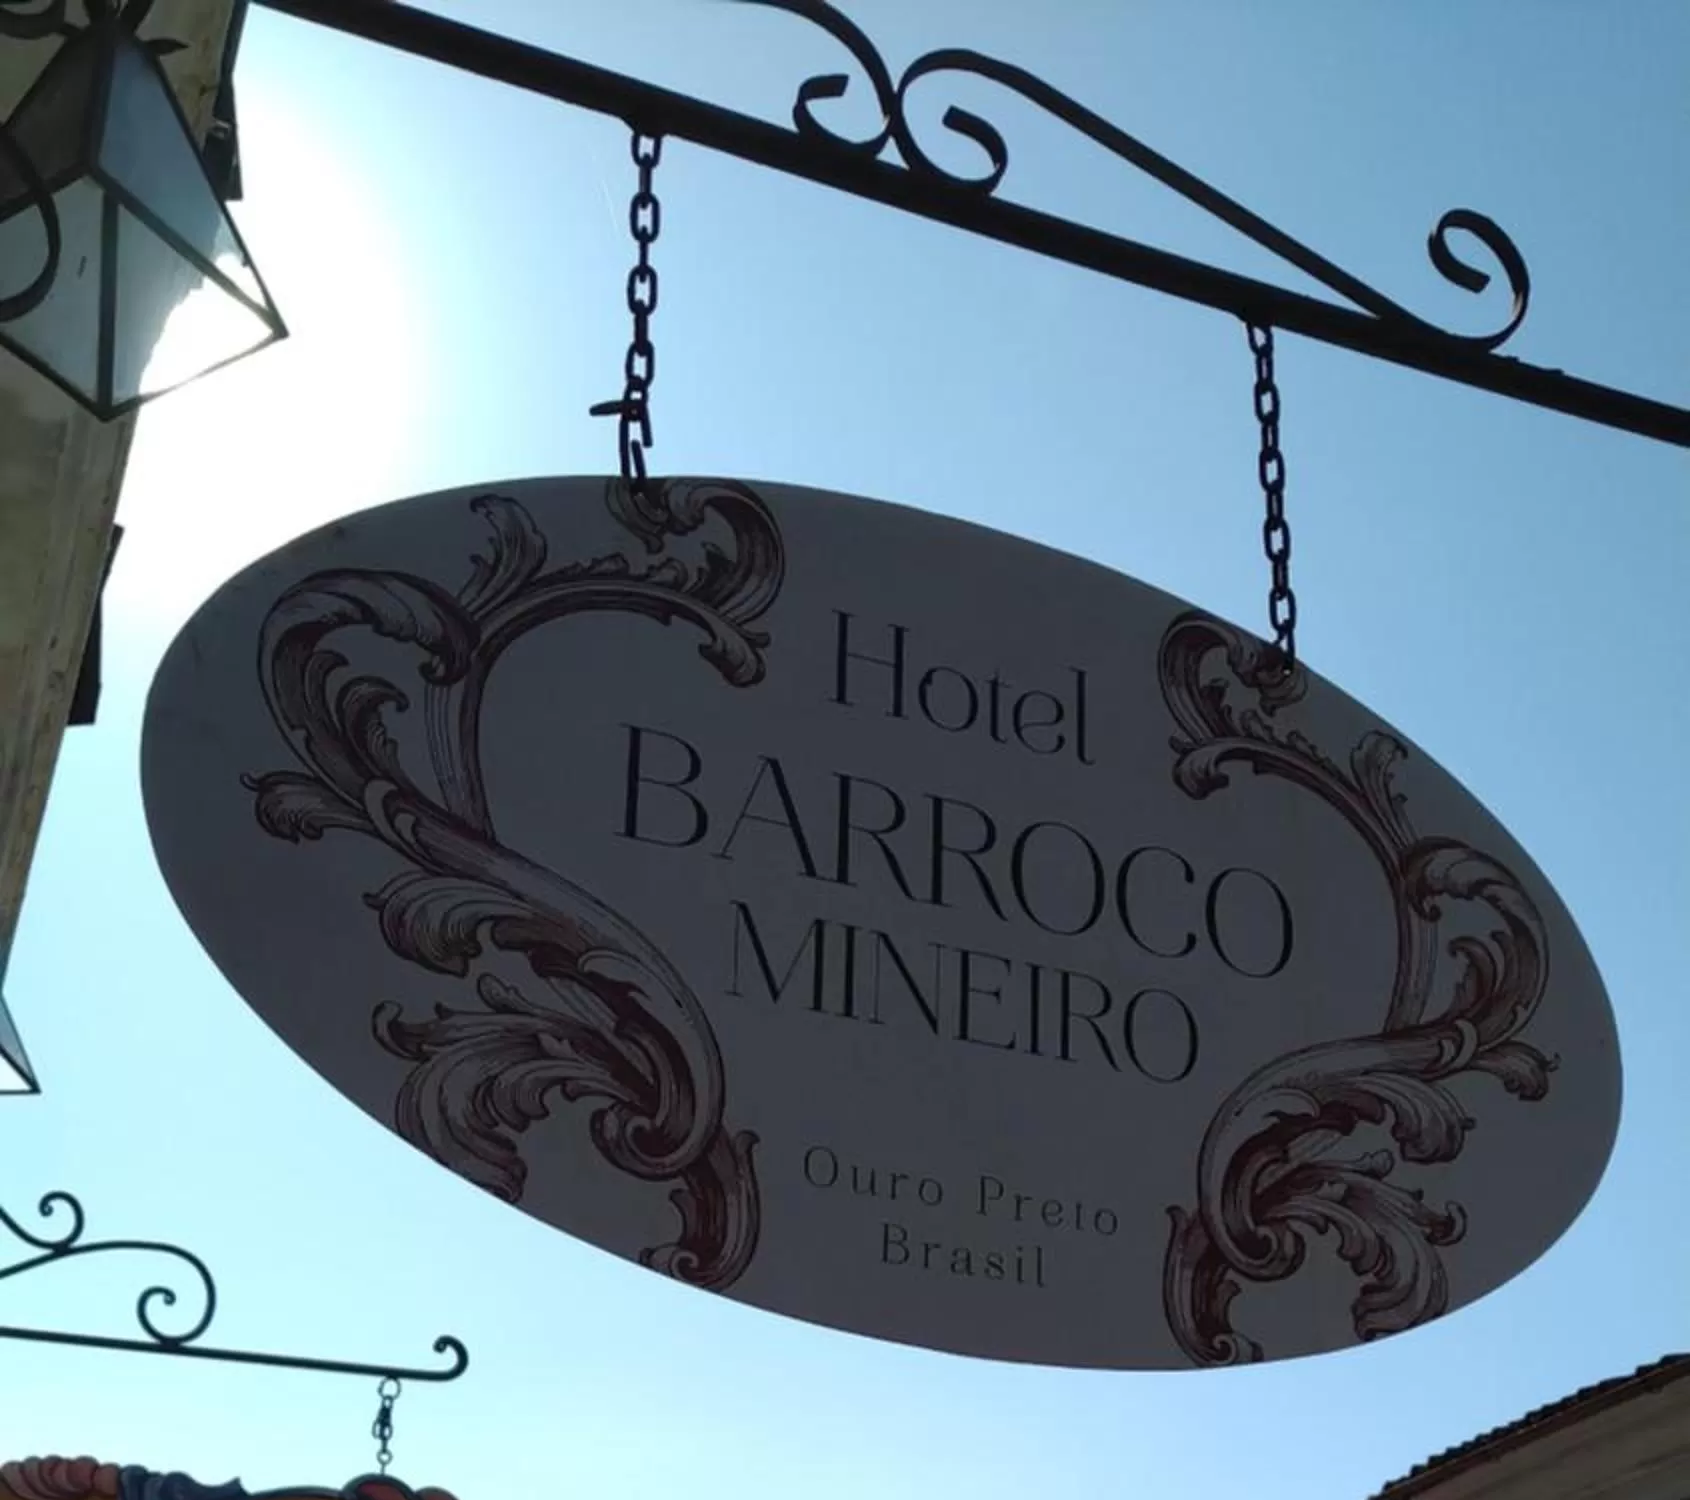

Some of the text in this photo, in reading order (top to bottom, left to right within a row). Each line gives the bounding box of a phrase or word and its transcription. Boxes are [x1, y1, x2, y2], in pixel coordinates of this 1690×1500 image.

[828, 608, 1096, 765] Hotel
[612, 723, 1294, 978] BARROCO
[723, 900, 1198, 1083] MINEIRO
[803, 1145, 1119, 1236] Ouro Preto
[881, 1222, 1047, 1288] Brasil
